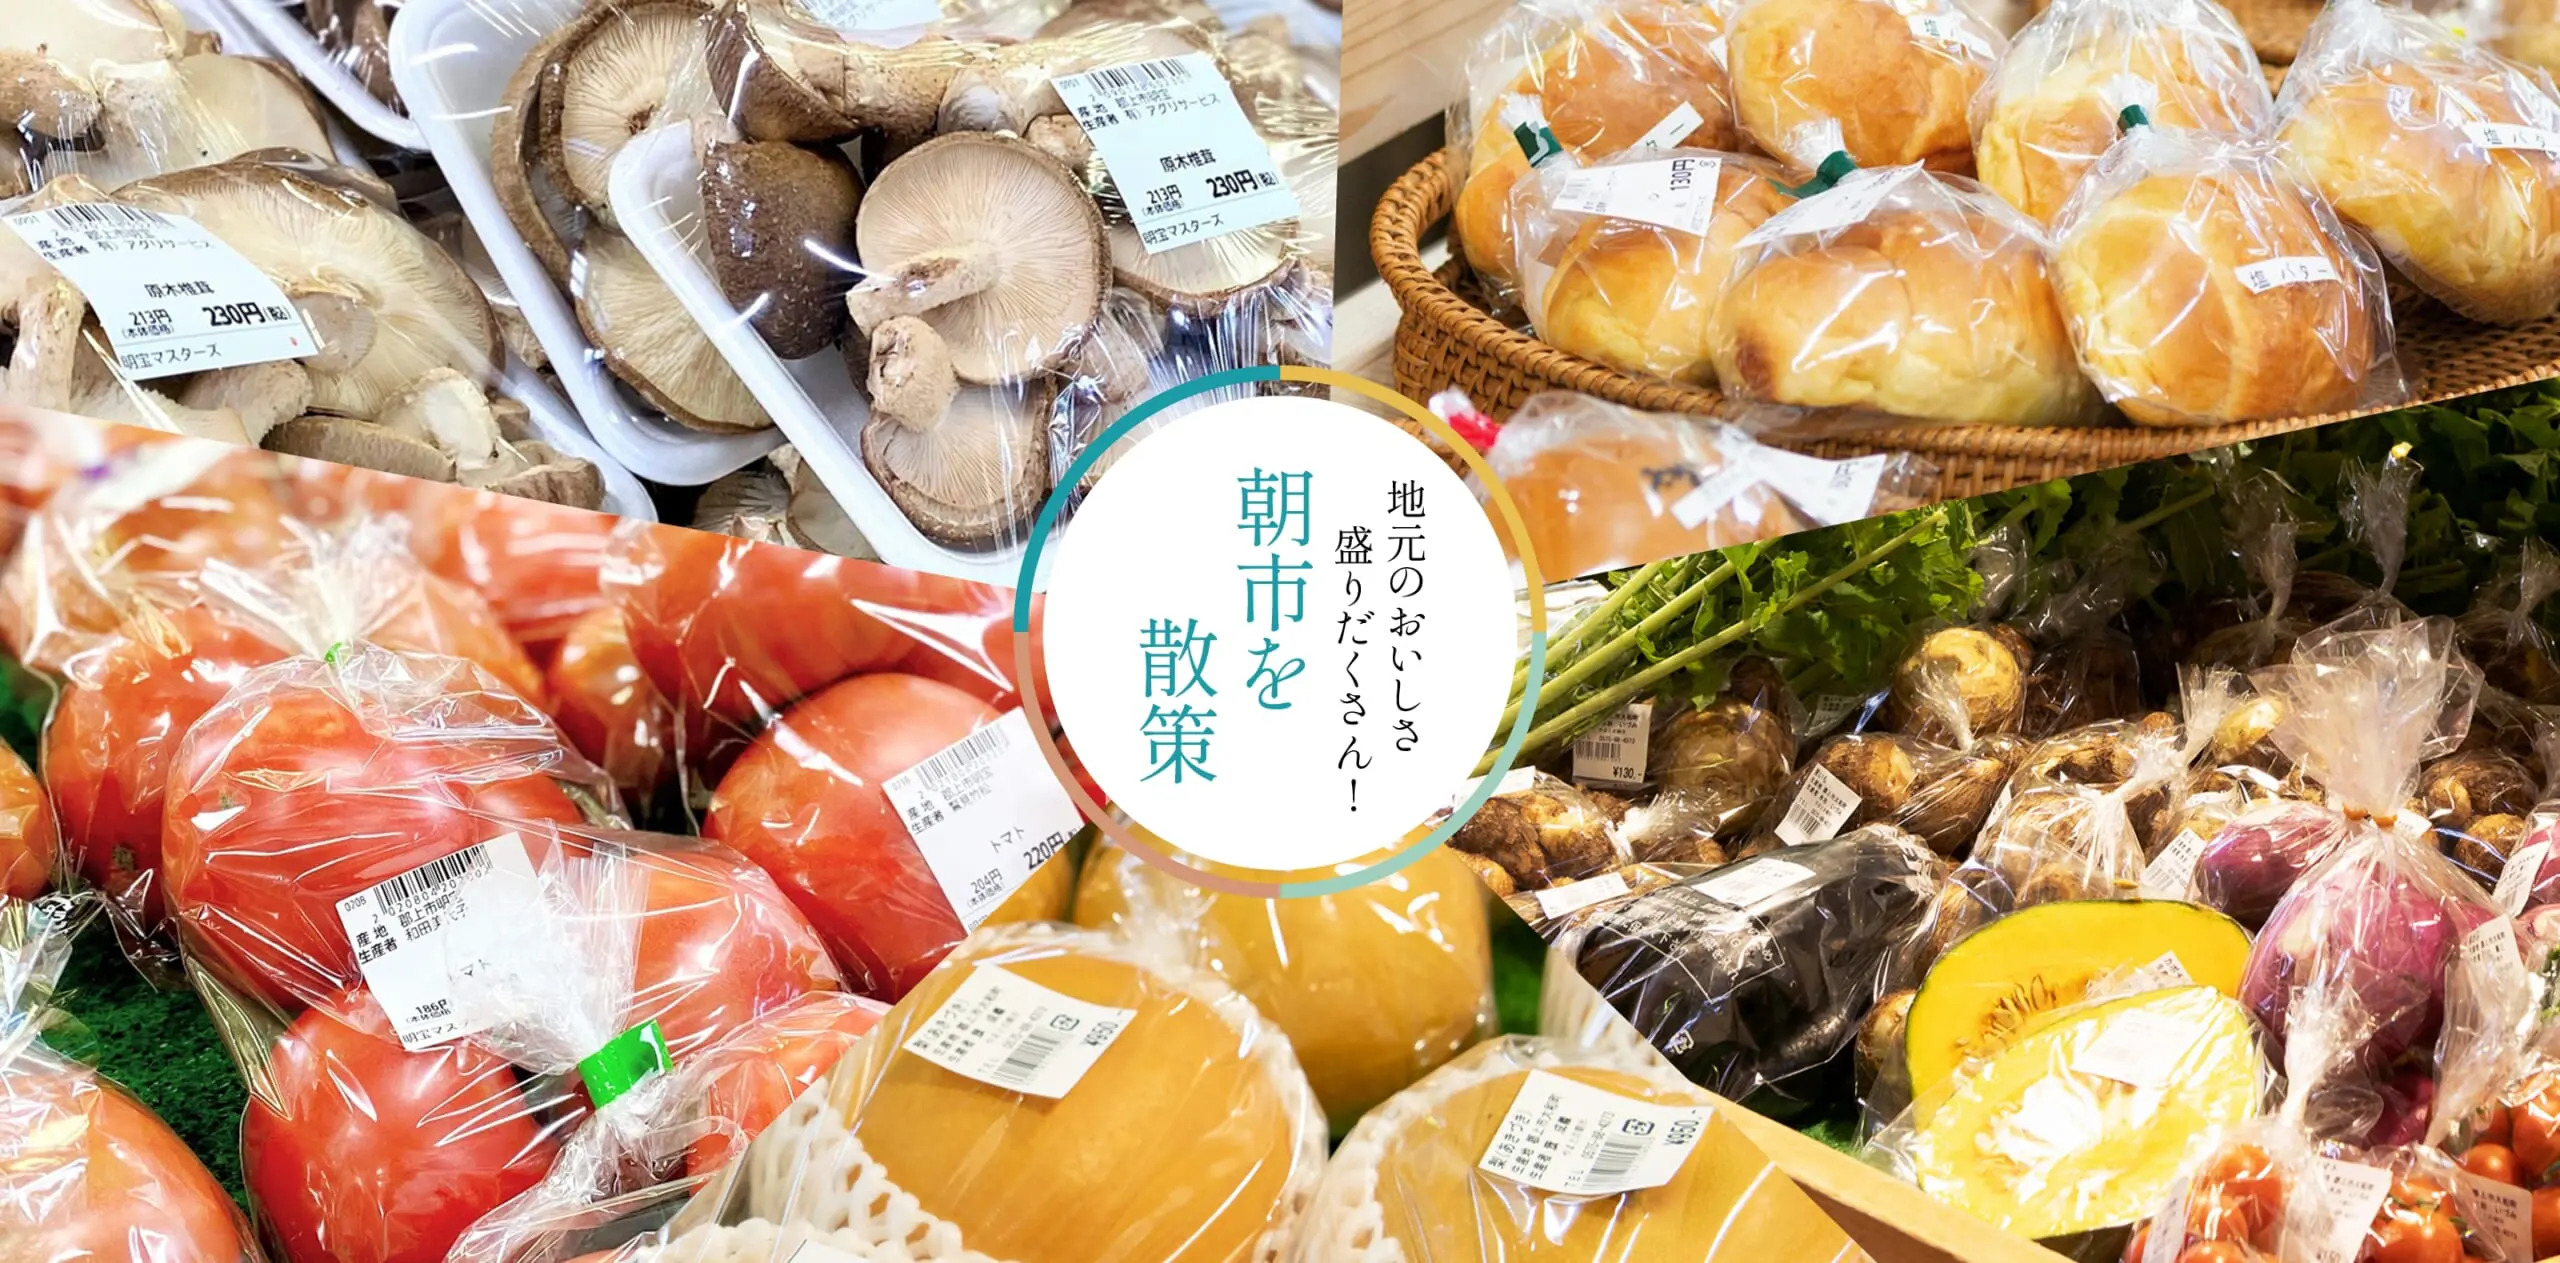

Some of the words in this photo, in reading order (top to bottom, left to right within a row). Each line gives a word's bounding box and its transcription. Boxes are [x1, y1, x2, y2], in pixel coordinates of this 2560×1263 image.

[1083, 113, 1119, 131] 生産者
[1147, 94, 1221, 117] アグリサービス
[1160, 149, 1216, 173] 原木椎茸
[1206, 169, 1258, 198] 230円
[1670, 159, 1695, 191] 130円
[1147, 184, 1183, 204] 213円
[144, 281, 215, 298] 原木椎茸
[129, 308, 172, 326] 213円
[202, 302, 266, 327] 230円
[907, 800, 936, 821] 産地
[911, 811, 944, 835] 生産者
[990, 826, 1024, 854] トマト
[1023, 831, 1064, 870] 220円
[971, 868, 1003, 894] 204円
[356, 924, 389, 948] 産地
[358, 937, 399, 964] 生産者
